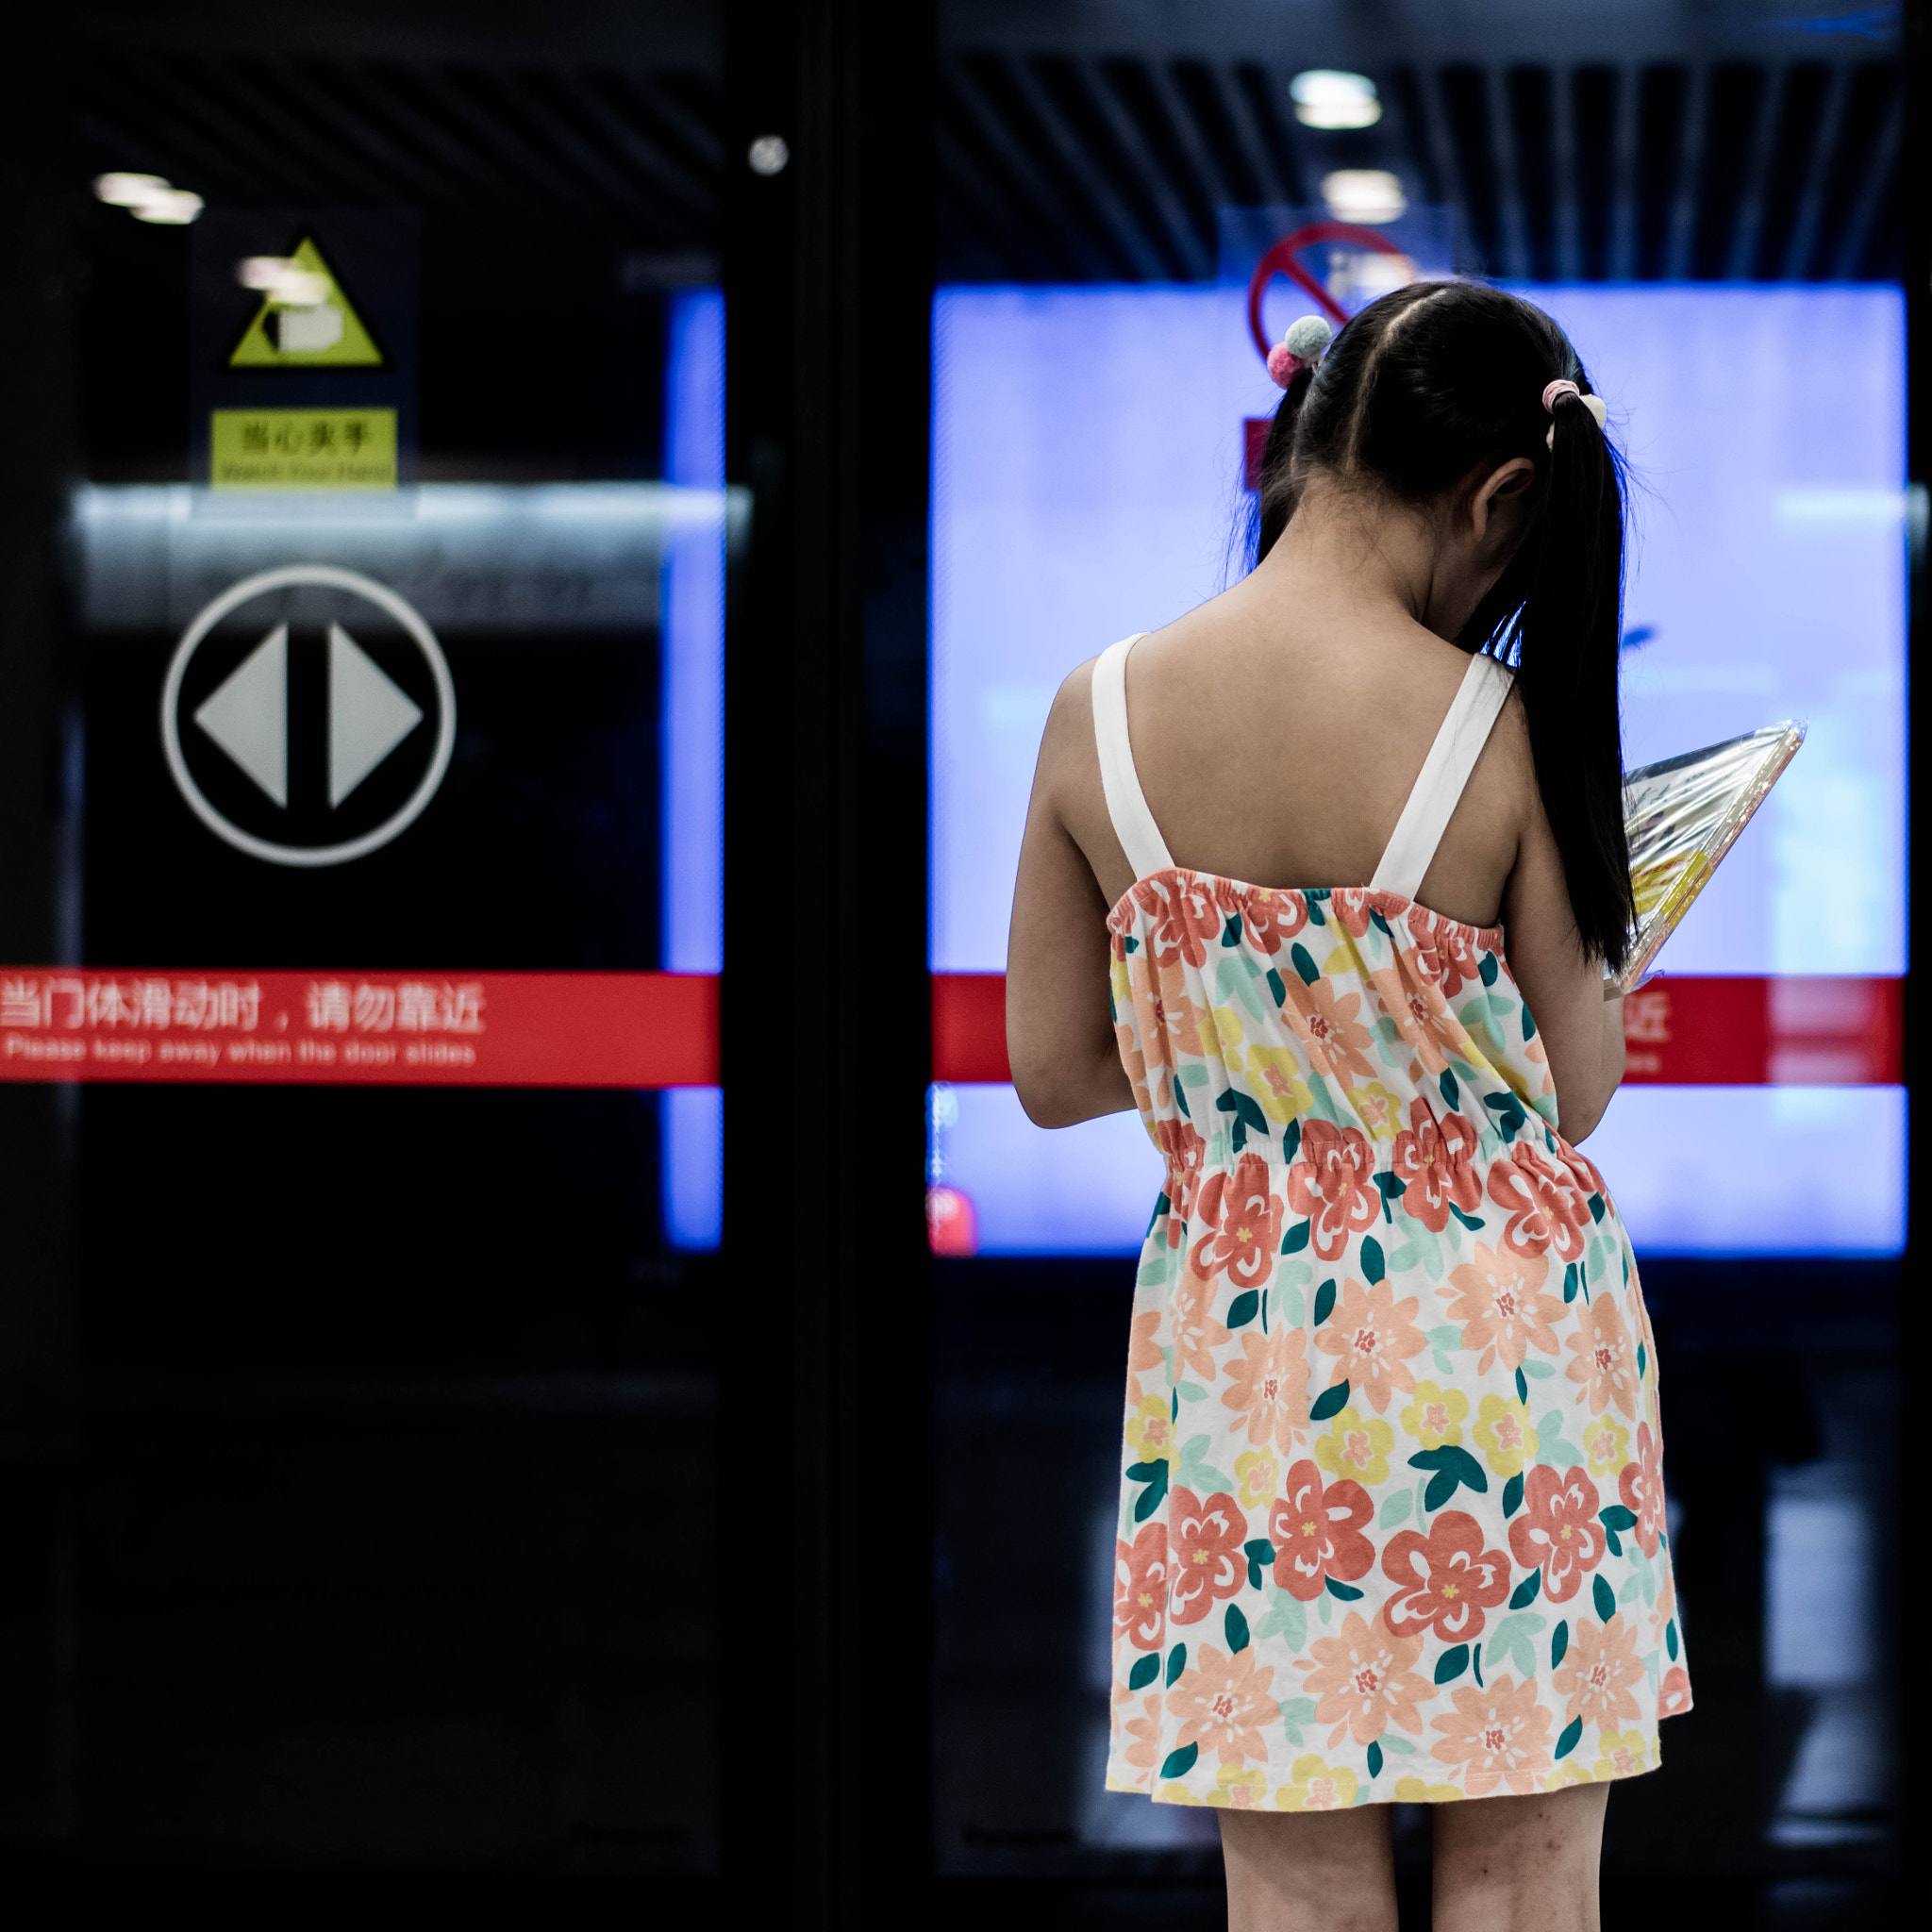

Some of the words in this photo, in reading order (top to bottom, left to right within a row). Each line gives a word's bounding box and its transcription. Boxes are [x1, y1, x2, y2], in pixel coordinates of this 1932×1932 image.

[5, 1033, 87, 1061] Please
[95, 1038, 152, 1065] keep
[159, 1039, 222, 1068] away
[228, 1040, 291, 1064] when
[299, 1040, 337, 1064] the
[343, 1040, 396, 1065] door
[405, 1041, 476, 1066] slides
